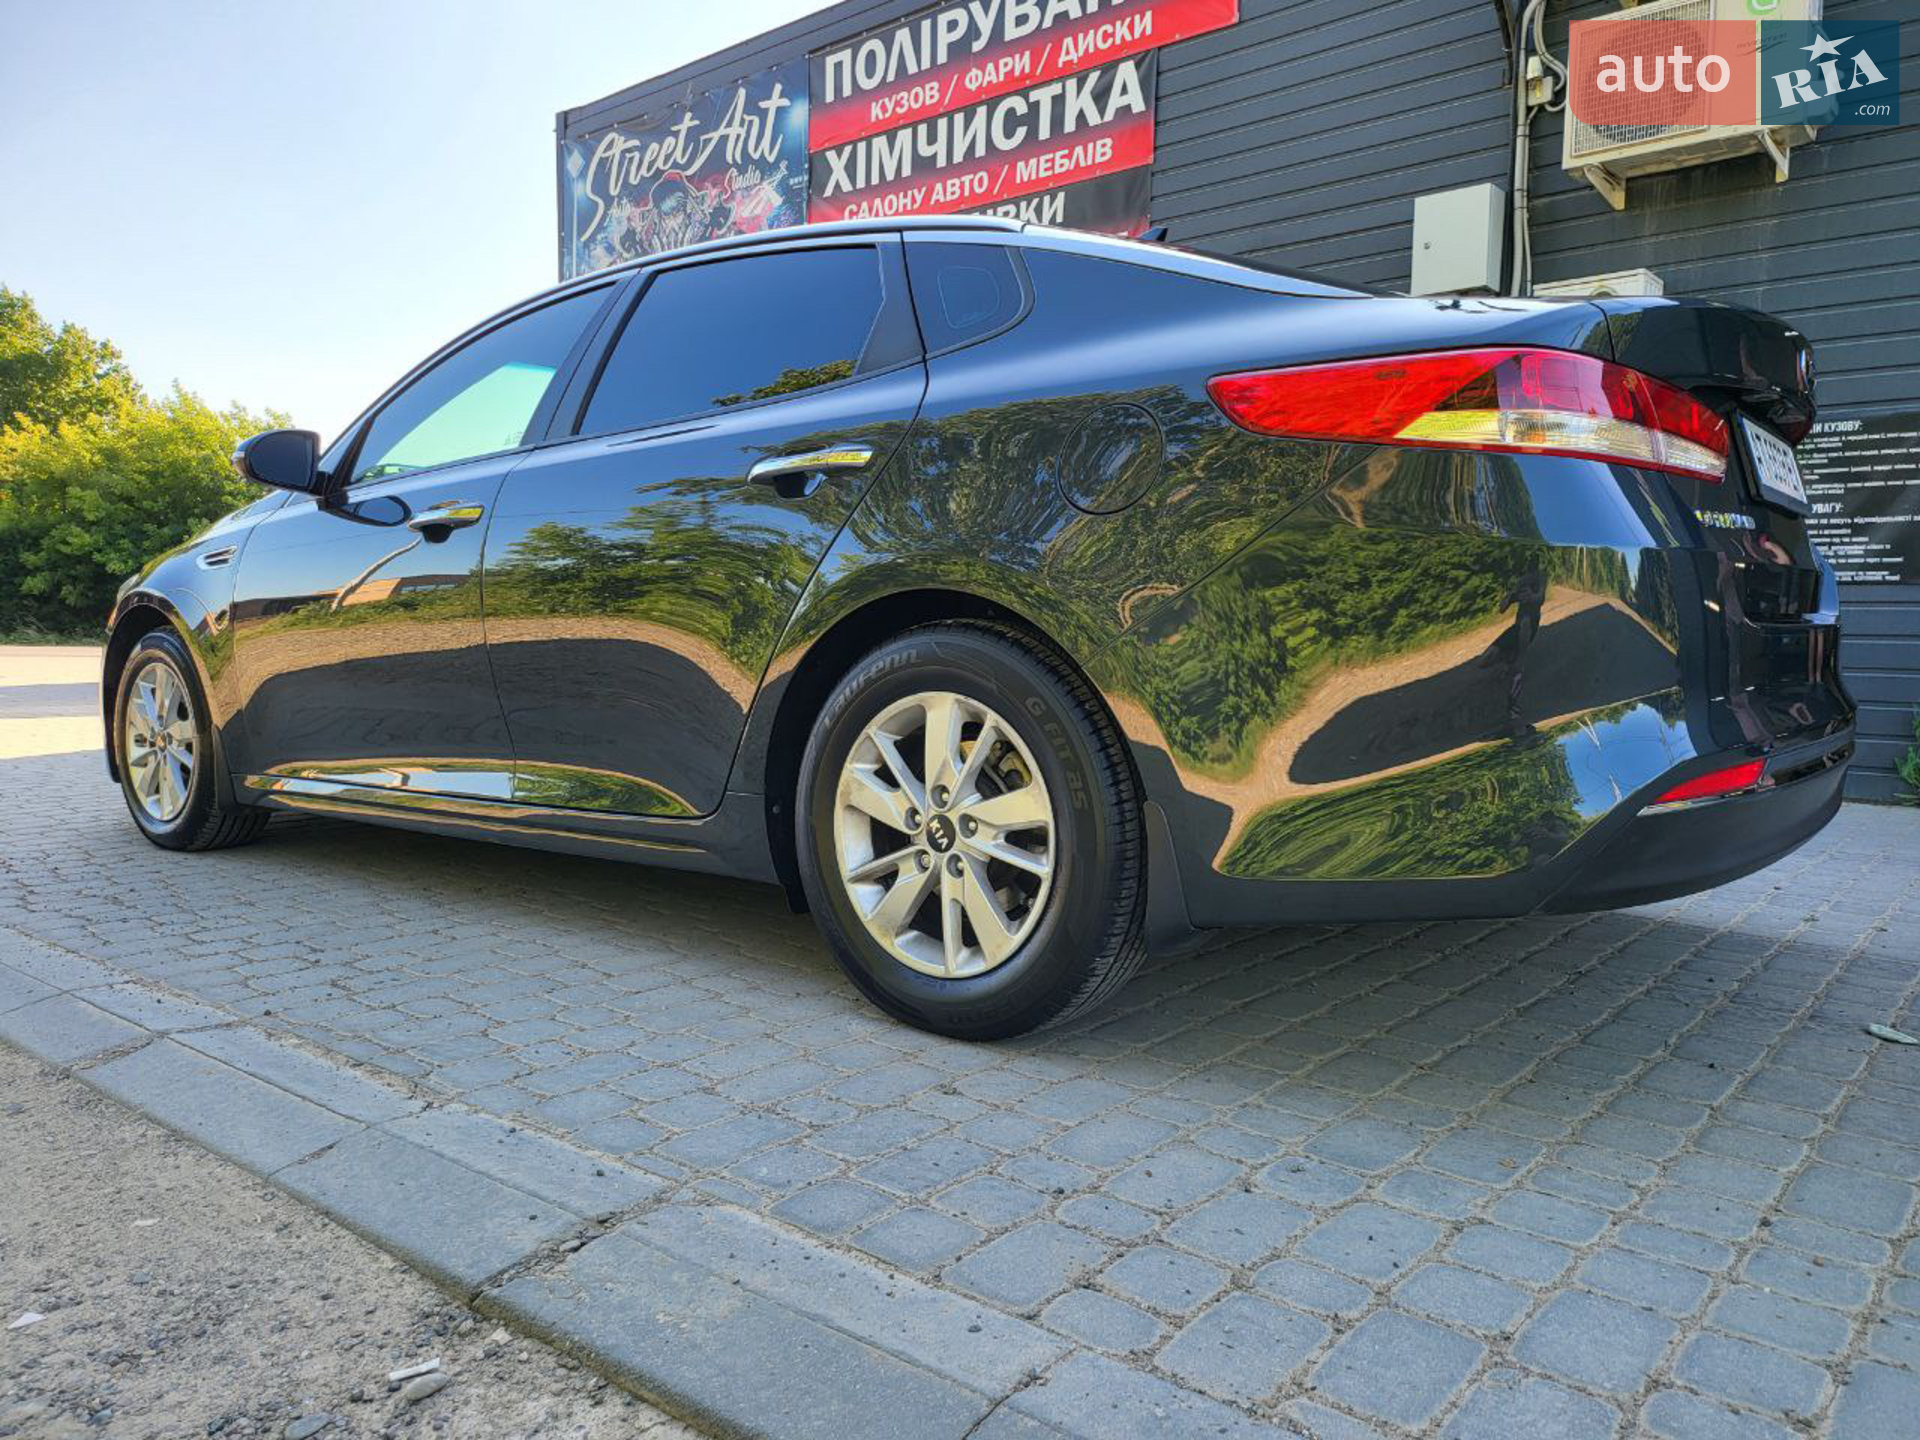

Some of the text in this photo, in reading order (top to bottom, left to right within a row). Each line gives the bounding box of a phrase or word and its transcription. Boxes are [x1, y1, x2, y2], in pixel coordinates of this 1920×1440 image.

[871, 81, 940, 121] КУЗОВ
[964, 50, 1031, 92] ФАРИ
[1057, 9, 1154, 68] ДИСКИ
[580, 82, 791, 243] Street Art
[820, 60, 1146, 198] ХІМЧИСТКА
[723, 164, 762, 199] Studio
[843, 186, 927, 220] САЛОНУ
[930, 170, 989, 206] АВТО
[1015, 137, 1113, 185] МЕБЛІВ
[929, 818, 949, 850] KIA
